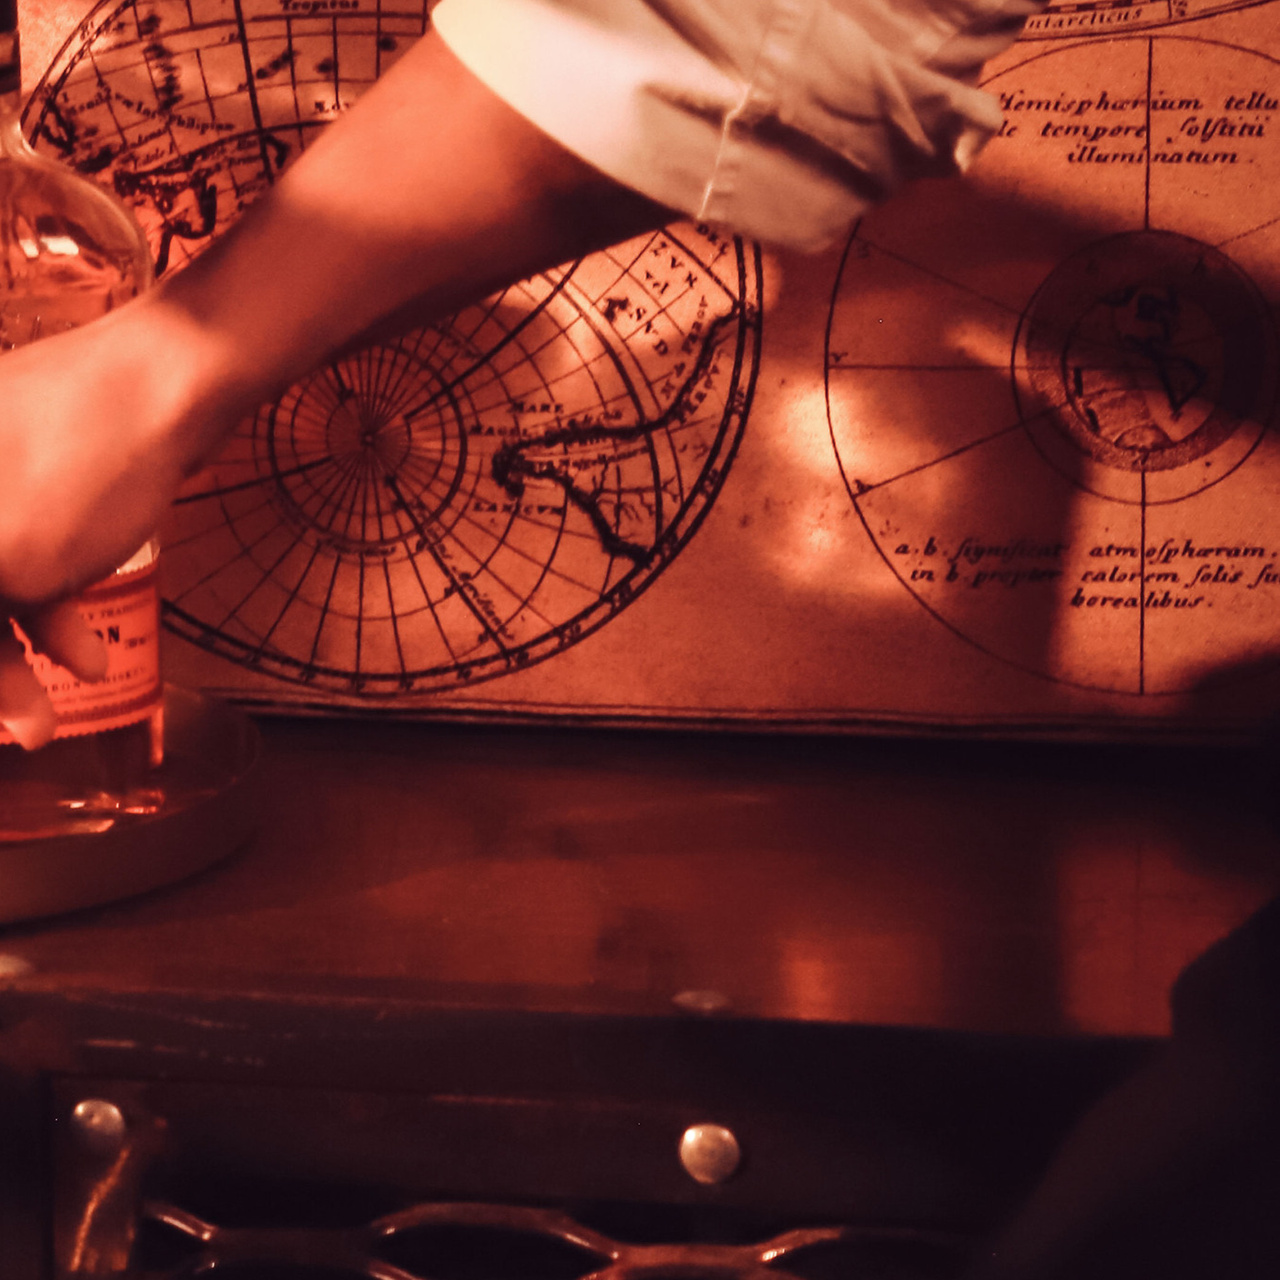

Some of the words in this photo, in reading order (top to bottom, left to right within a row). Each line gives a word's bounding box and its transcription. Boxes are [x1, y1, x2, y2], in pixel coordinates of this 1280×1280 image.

[1224, 90, 1280, 111] tellu
[1040, 121, 1148, 143] tempore
[910, 566, 934, 582] in
[1080, 565, 1180, 584] calorem
